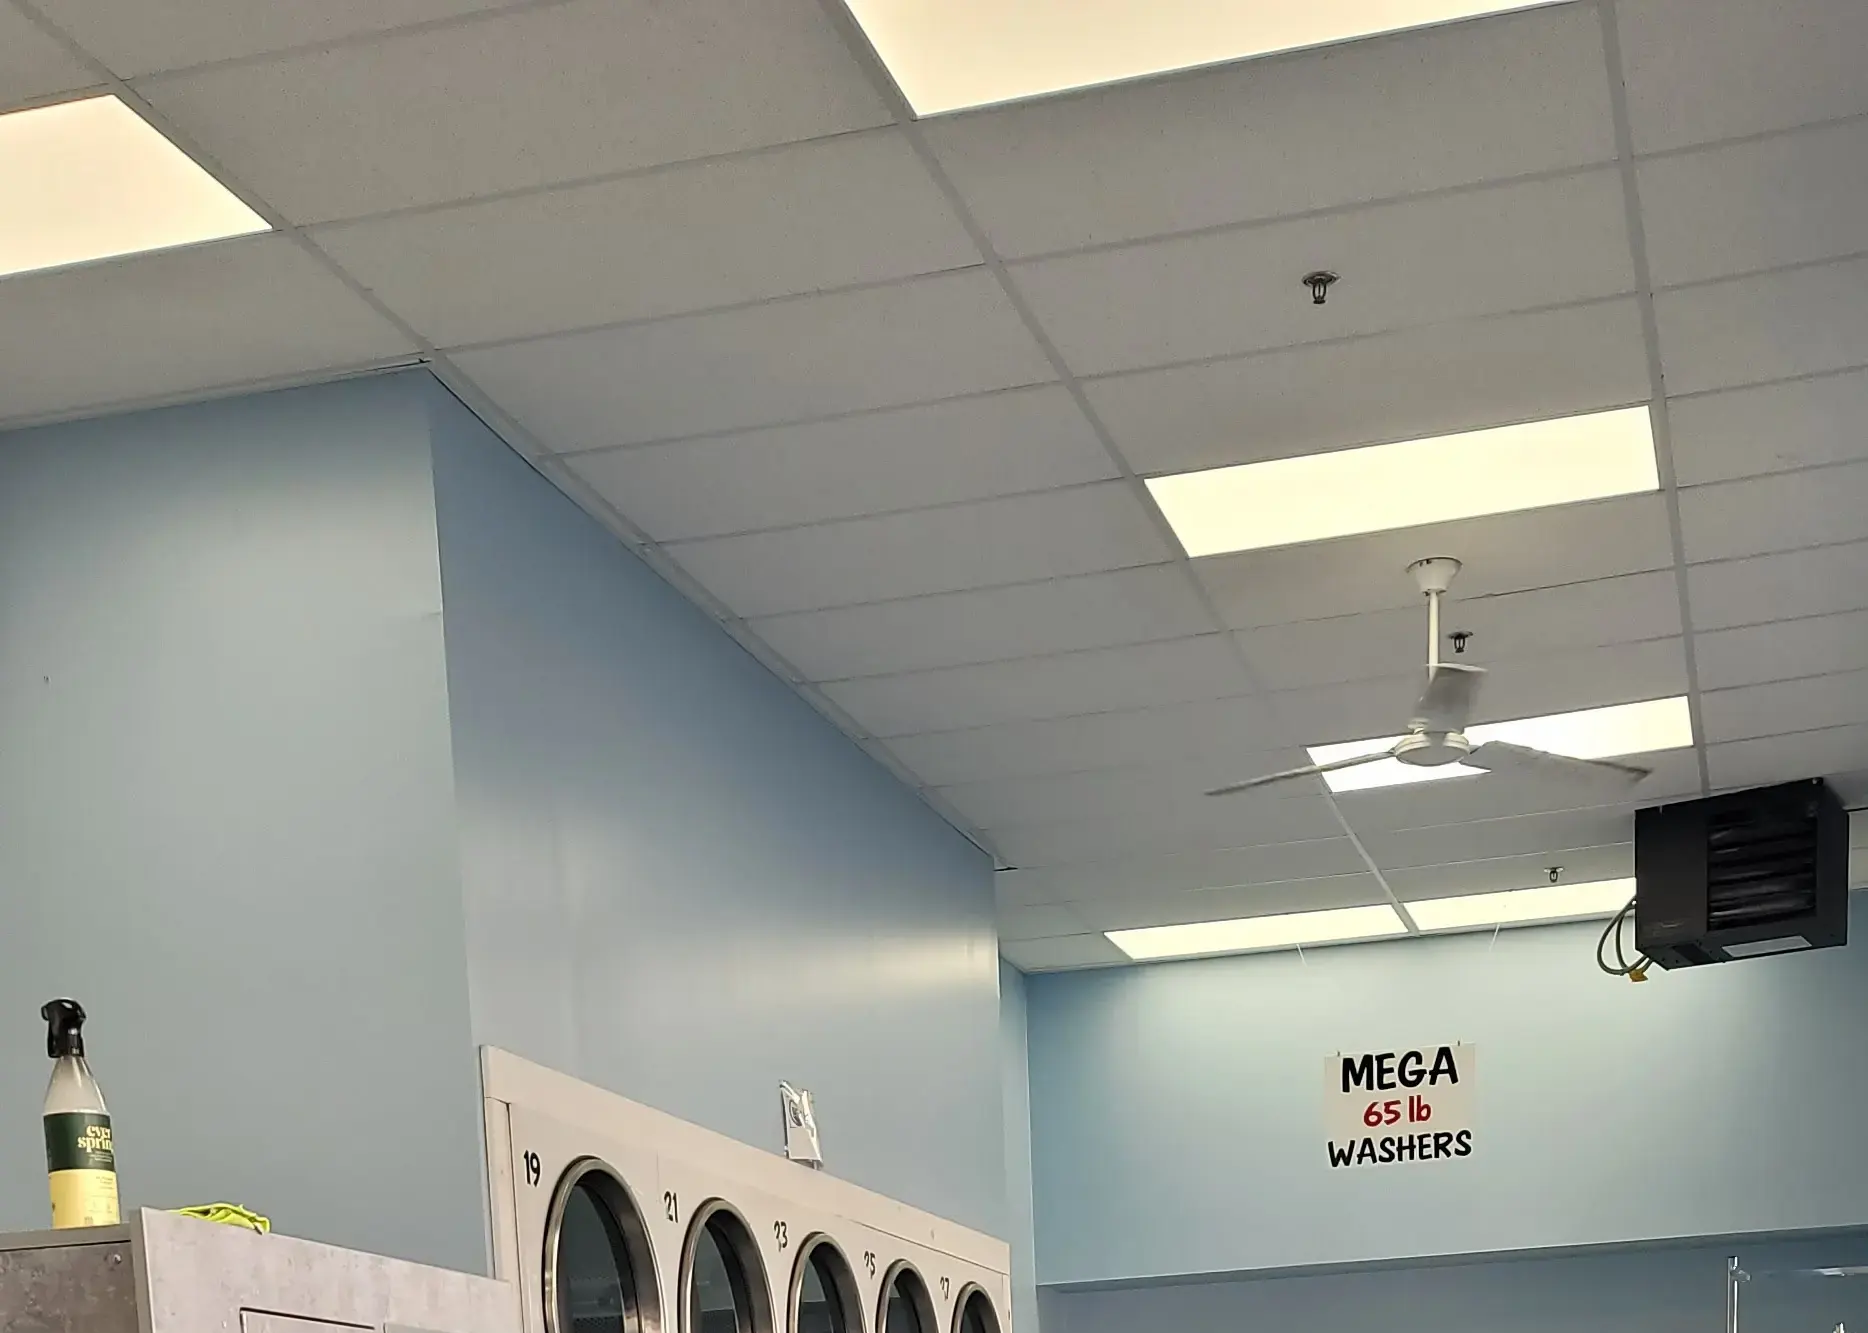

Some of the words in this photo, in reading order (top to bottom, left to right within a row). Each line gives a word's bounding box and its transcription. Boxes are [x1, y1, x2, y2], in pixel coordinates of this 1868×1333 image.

[1342, 1046, 1459, 1093] MEGA
[1363, 1099, 1402, 1127] 65
[1408, 1094, 1432, 1123] lb
[77, 1135, 113, 1153] sprin
[1327, 1129, 1472, 1168] WASHERS
[523, 1149, 541, 1187] 19
[664, 1191, 679, 1223] 21
